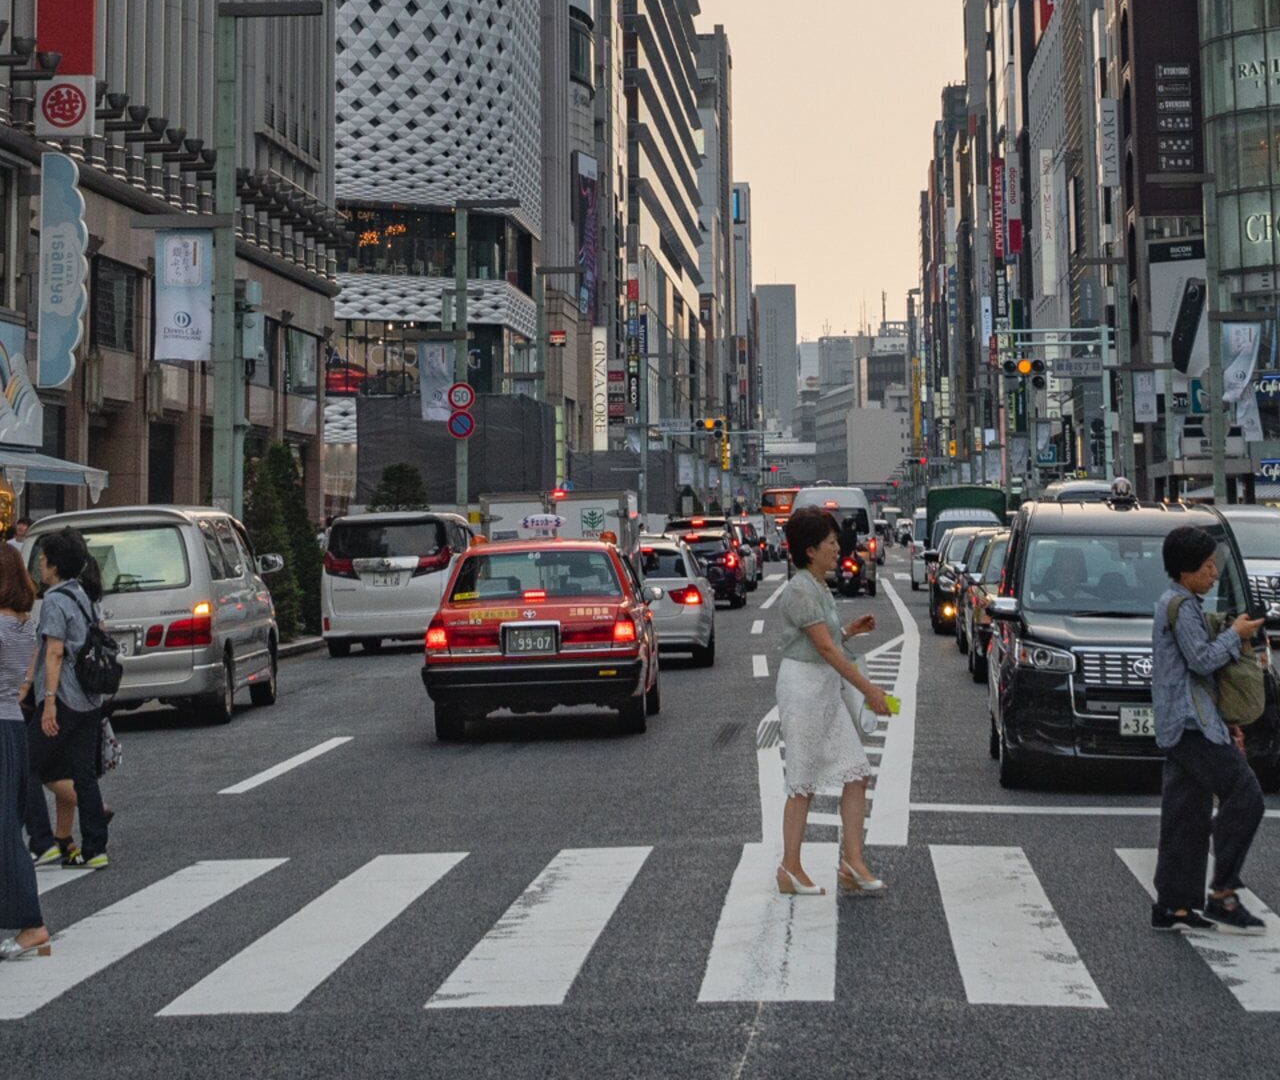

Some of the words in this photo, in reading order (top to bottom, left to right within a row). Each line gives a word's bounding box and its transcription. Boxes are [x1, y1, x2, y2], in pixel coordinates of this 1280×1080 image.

[1103, 109, 1117, 178] TASAKI
[1008, 167, 1018, 205] docomo
[594, 339, 607, 387] GINZA
[453, 390, 469, 403] 50
[594, 391, 608, 434] CORE
[517, 636, 552, 651] 99-07
